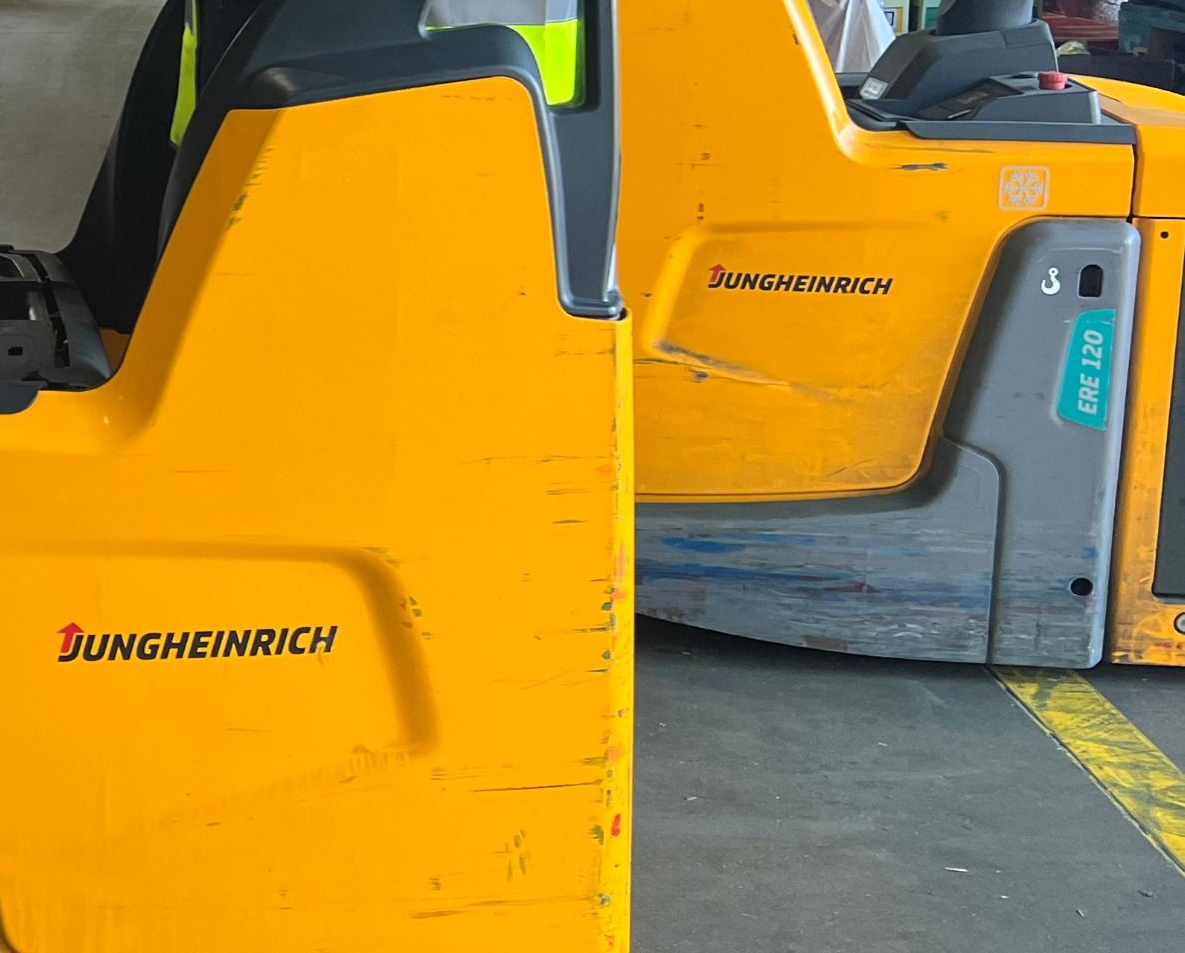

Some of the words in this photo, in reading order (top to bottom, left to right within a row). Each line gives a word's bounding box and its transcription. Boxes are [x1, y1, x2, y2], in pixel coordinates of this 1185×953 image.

[709, 270, 894, 295] JUNGHEINRICH
[1081, 329, 1104, 370] 120
[1077, 373, 1101, 416] ERE
[57, 624, 339, 662] JUNGHEINRICH
